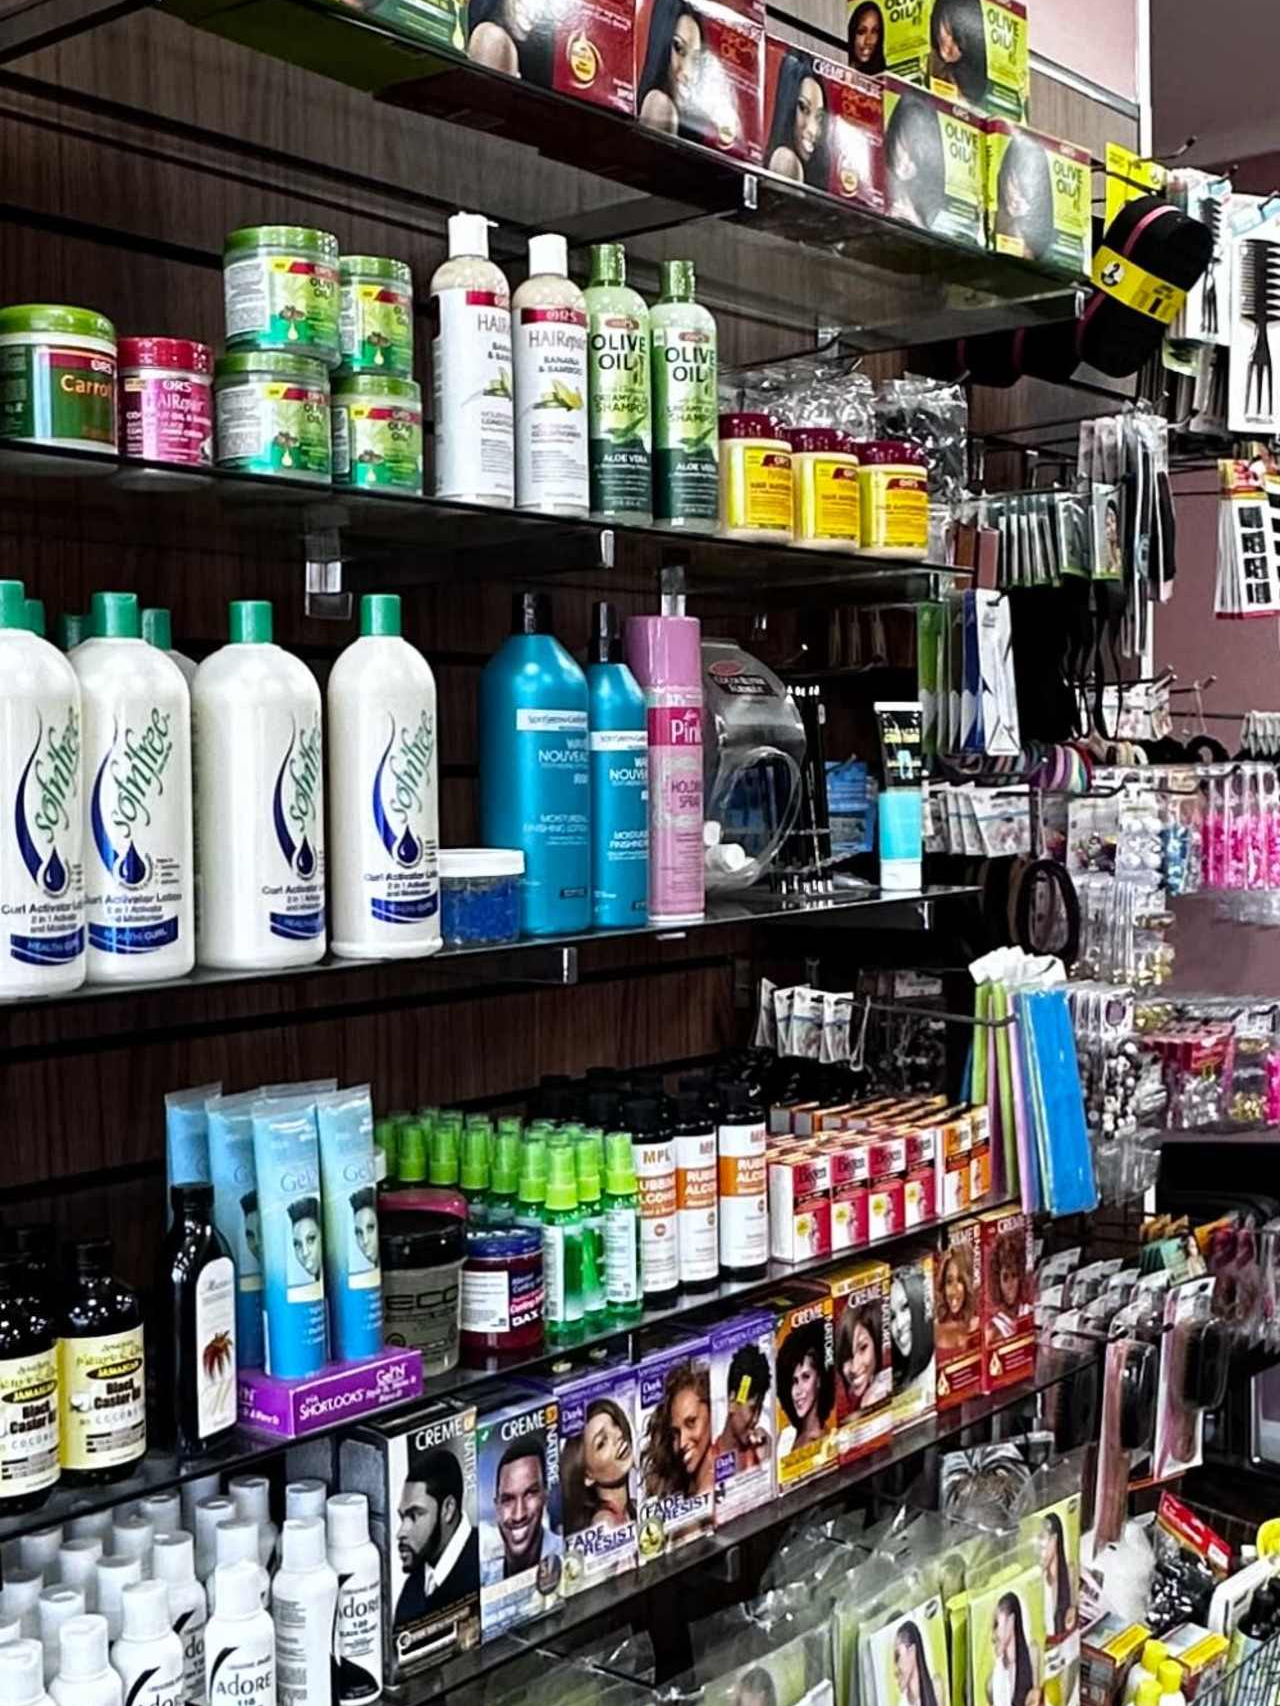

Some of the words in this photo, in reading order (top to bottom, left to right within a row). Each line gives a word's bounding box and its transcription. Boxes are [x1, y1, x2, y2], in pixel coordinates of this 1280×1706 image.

[890, 6, 916, 24] OIL
[986, 7, 1019, 37] OLIVE
[944, 121, 978, 146] OLIVE
[590, 333, 647, 355] OLIVE
[664, 345, 716, 368] OLIVE
[597, 353, 634, 371] OIL
[672, 366, 707, 383] OIL
[848, 1287, 883, 1309] CREME
[789, 1305, 824, 1329] CREME
[415, 1417, 465, 1451] CREME
[500, 1410, 545, 1442] CREME
[545, 1424, 560, 1487] NATURE
[644, 1493, 685, 1521] FADE
[660, 1495, 710, 1522] RESIST
[567, 1524, 605, 1552] FADE
[583, 1524, 636, 1557] RESIST
